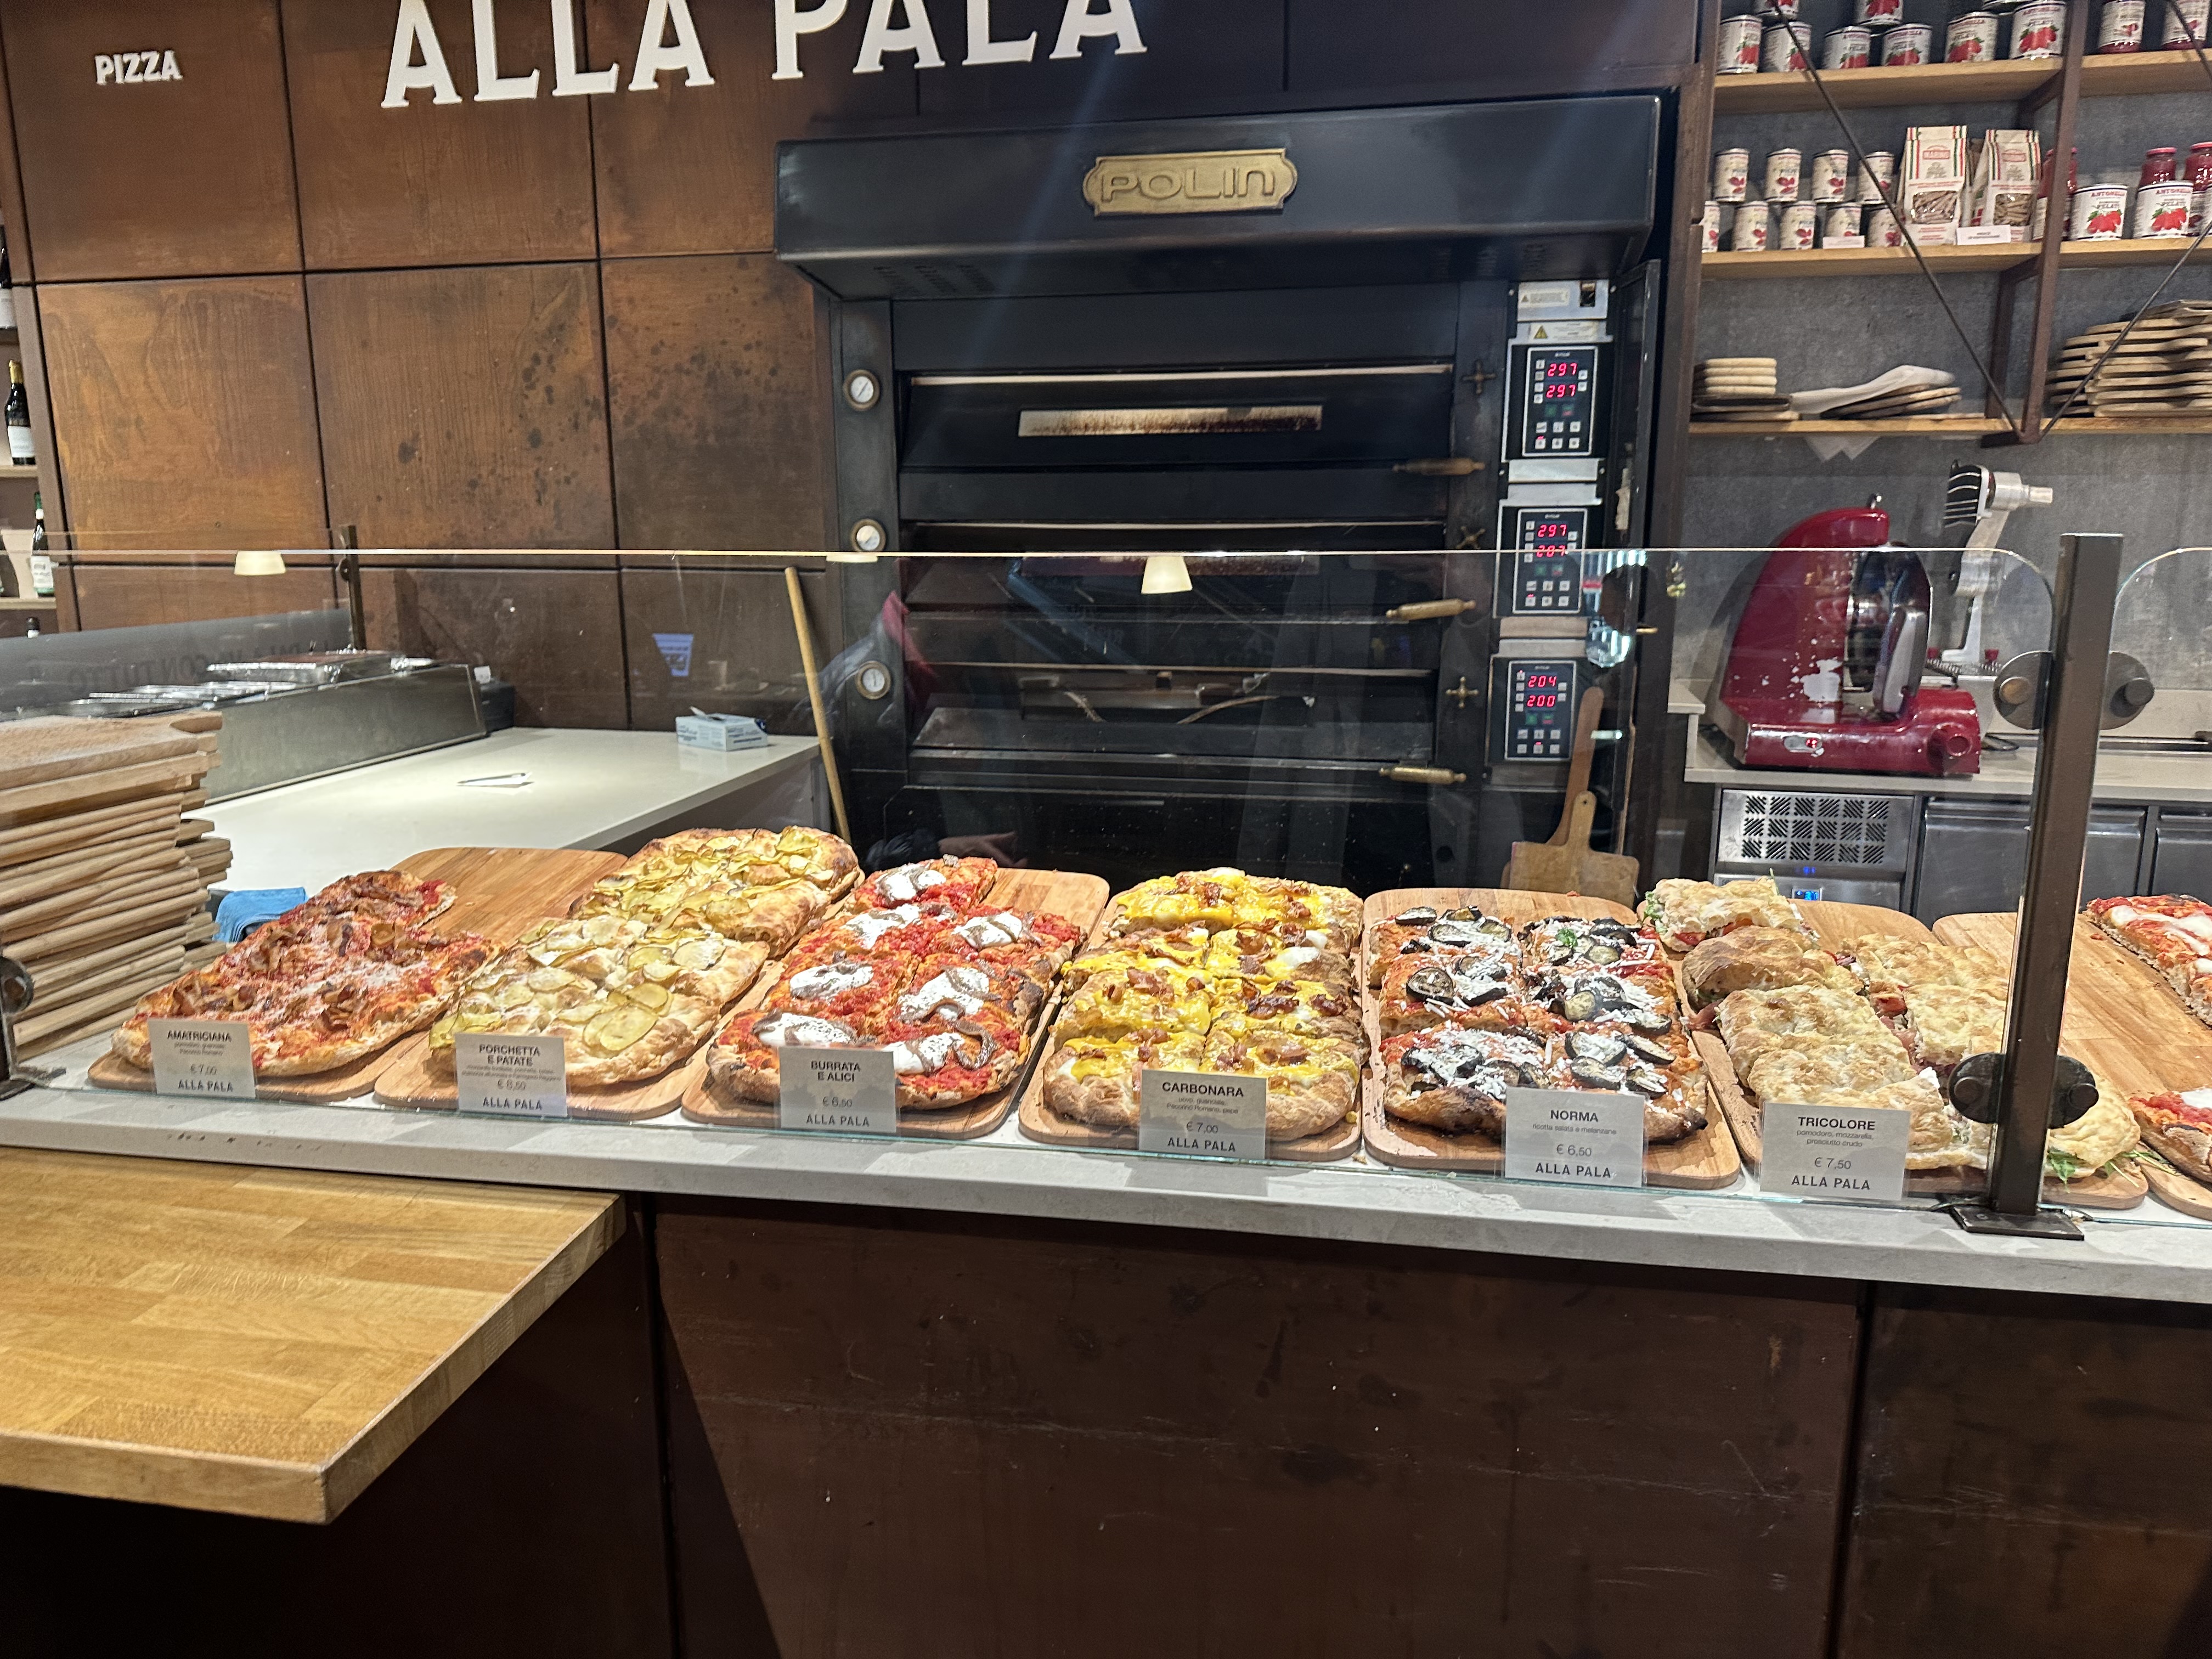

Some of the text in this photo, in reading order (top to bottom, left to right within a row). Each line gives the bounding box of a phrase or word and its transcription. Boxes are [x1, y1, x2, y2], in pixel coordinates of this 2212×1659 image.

[381, 0, 715, 108] ALLA
[94, 49, 183, 86] PIZZA
[1548, 363, 1577, 376] 297
[1546, 385, 1576, 398] 297
[1537, 524, 1567, 538] 297
[1528, 675, 1557, 688] 204
[1527, 695, 1556, 707] 200
[479, 1044, 540, 1057] PORCHETTA
[488, 1054, 533, 1066] E PATATE
[811, 1060, 861, 1071] BURRATA
[817, 1071, 854, 1082] E ALICI
[178, 1079, 234, 1092] ALLA PALA
[498, 1079, 504, 1090] €
[1162, 1081, 1244, 1097] CARBONARA
[483, 1097, 542, 1111] ALLA PALA
[822, 1096, 829, 1107] €
[806, 1114, 870, 1127] ALLA PALA
[1550, 1109, 1599, 1122] NORMA
[1186, 1121, 1218, 1134] € 7,00
[1798, 1116, 1876, 1130] TRICOLORE
[1581, 1127, 1617, 1135] melanzane
[1836, 1132, 1874, 1140] mozzarella,
[1167, 1137, 1236, 1152] ALLA PALA
[1556, 1144, 1592, 1156] € 6,50
[1814, 1157, 1852, 1170] € 7,50
[1536, 1163, 1611, 1178] ALLA PALA
[1791, 1175, 1870, 1190] ALLA PALA
